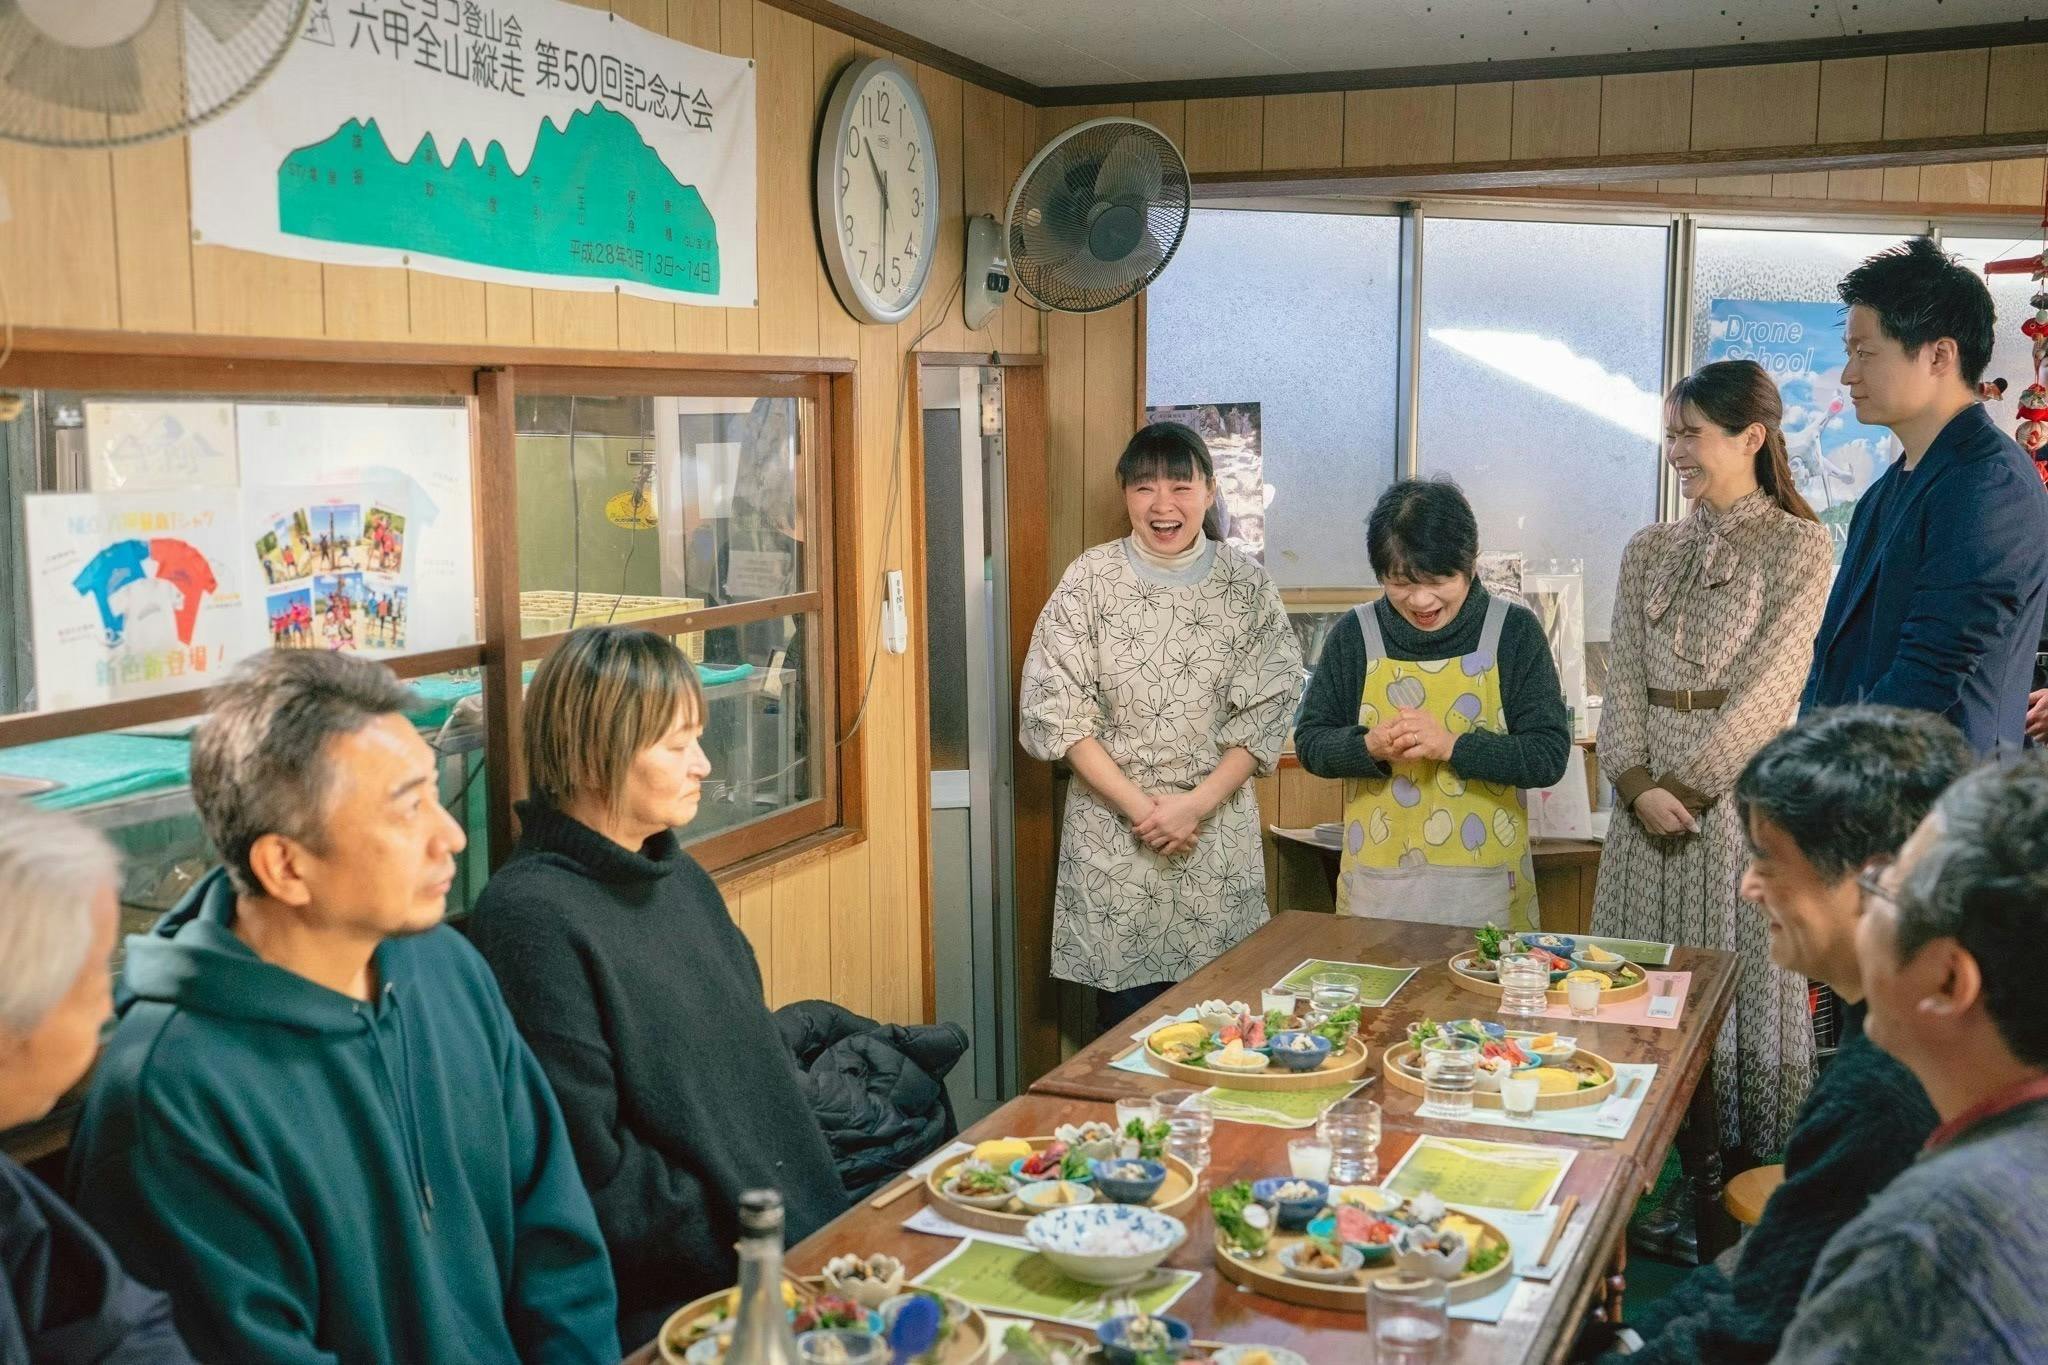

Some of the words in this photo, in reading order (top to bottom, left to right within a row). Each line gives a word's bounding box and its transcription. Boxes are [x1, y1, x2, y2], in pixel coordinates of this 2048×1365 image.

[349, 2, 526, 97] 六甲全山縦走
[535, 39, 713, 132] 第50回記念大会
[862, 94, 872, 128] 11
[877, 90, 891, 124] 12
[907, 142, 916, 173] 2
[911, 187, 920, 218] 3
[904, 231, 914, 259] 4
[858, 249, 868, 280] 7
[873, 263, 884, 294] 6
[891, 256, 902, 288] 5
[1724, 314, 1803, 344] Drone
